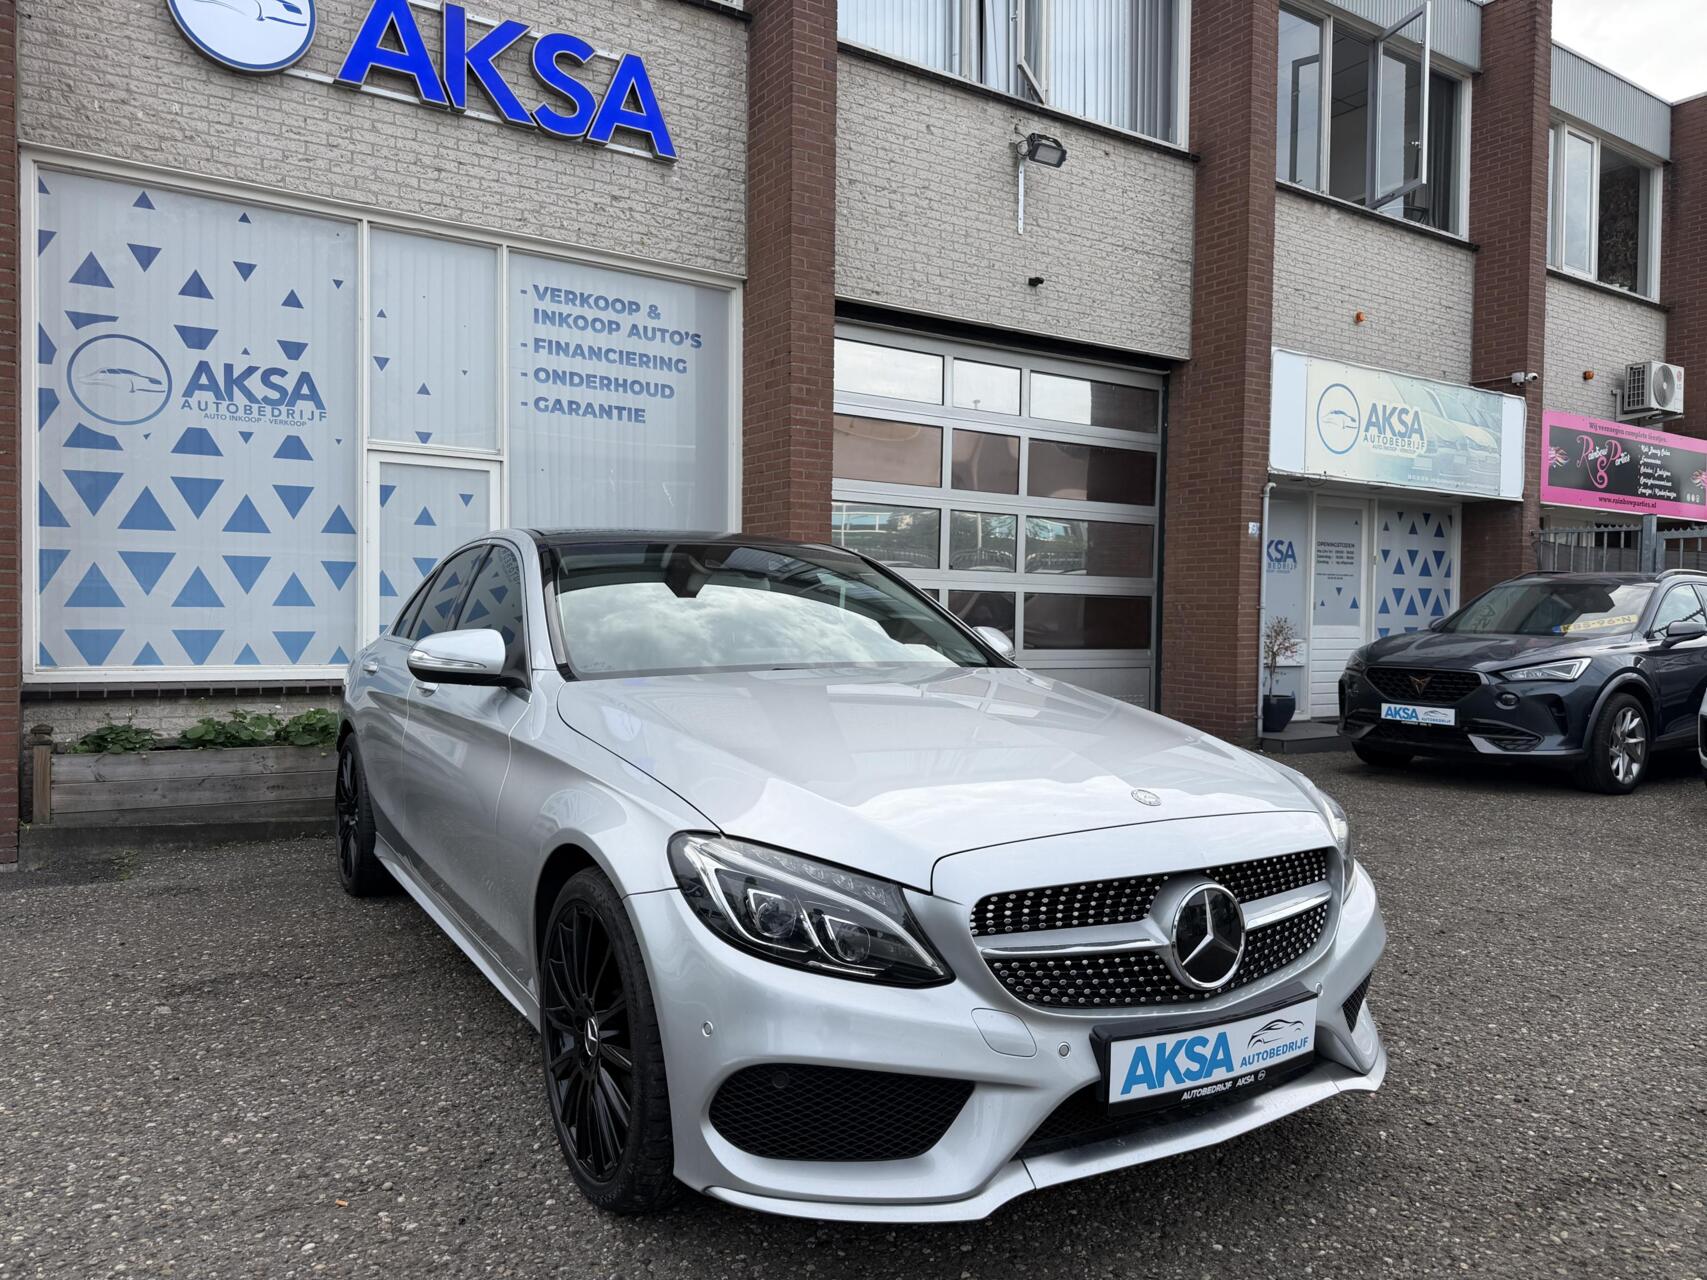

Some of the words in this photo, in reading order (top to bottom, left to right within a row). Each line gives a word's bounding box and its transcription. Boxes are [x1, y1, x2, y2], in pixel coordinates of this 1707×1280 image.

[336, 0, 678, 162] AKSA
[533, 284, 641, 316] VERKOOP
[647, 304, 661, 320] &
[533, 308, 621, 335] INKOOP
[627, 323, 702, 349] AUTO'S
[533, 337, 687, 374] FINANCIERING
[181, 360, 326, 411] AKSA
[533, 367, 675, 399] ONDERHOUD
[180, 399, 328, 422] AUTOBEDRIJF
[203, 412, 227, 421] AUTO
[228, 414, 262, 424] INKOOP
[268, 418, 307, 427] VERKOOP
[533, 396, 646, 424] GARANTIE
[1363, 402, 1425, 441] AKSA
[1363, 432, 1426, 450] AUTOBEDRIJF
[1266, 539, 1297, 563] KSA
[1384, 706, 1419, 721] AKSA
[1120, 1031, 1235, 1096] AKSA
[1239, 1036, 1309, 1069] AUTOBEDRIJF
[1181, 1081, 1233, 1101] AUTOBEDRIJF
[1236, 1074, 1255, 1088] AKSA
